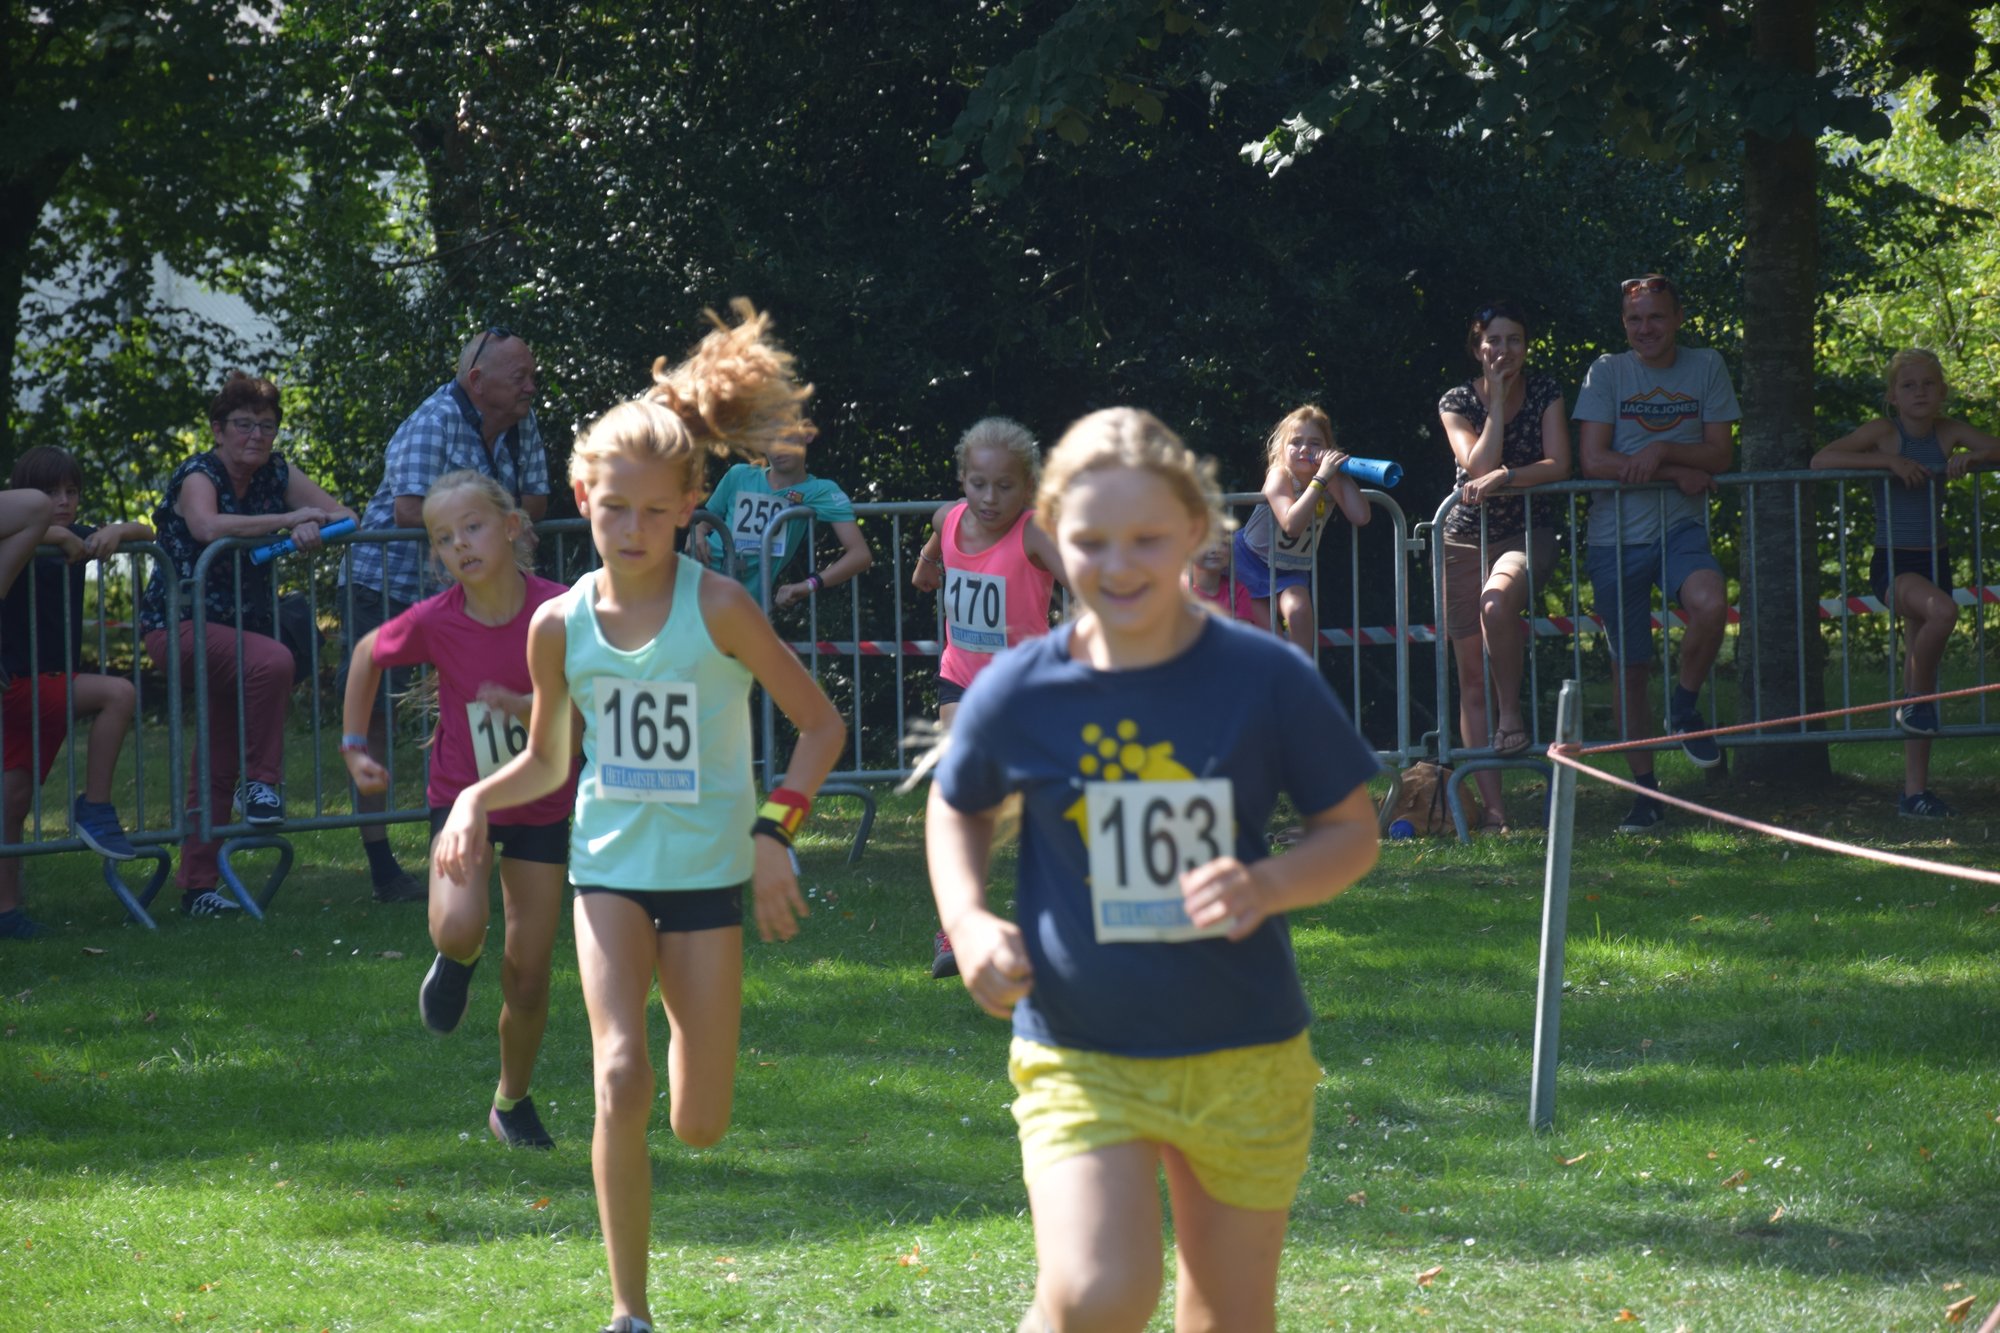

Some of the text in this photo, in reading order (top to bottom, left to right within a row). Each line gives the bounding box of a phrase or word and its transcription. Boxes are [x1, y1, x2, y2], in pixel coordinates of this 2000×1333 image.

[950, 576, 1000, 628] 170
[478, 710, 529, 764] 16
[604, 688, 690, 761] 165
[1101, 797, 1220, 888] 163
